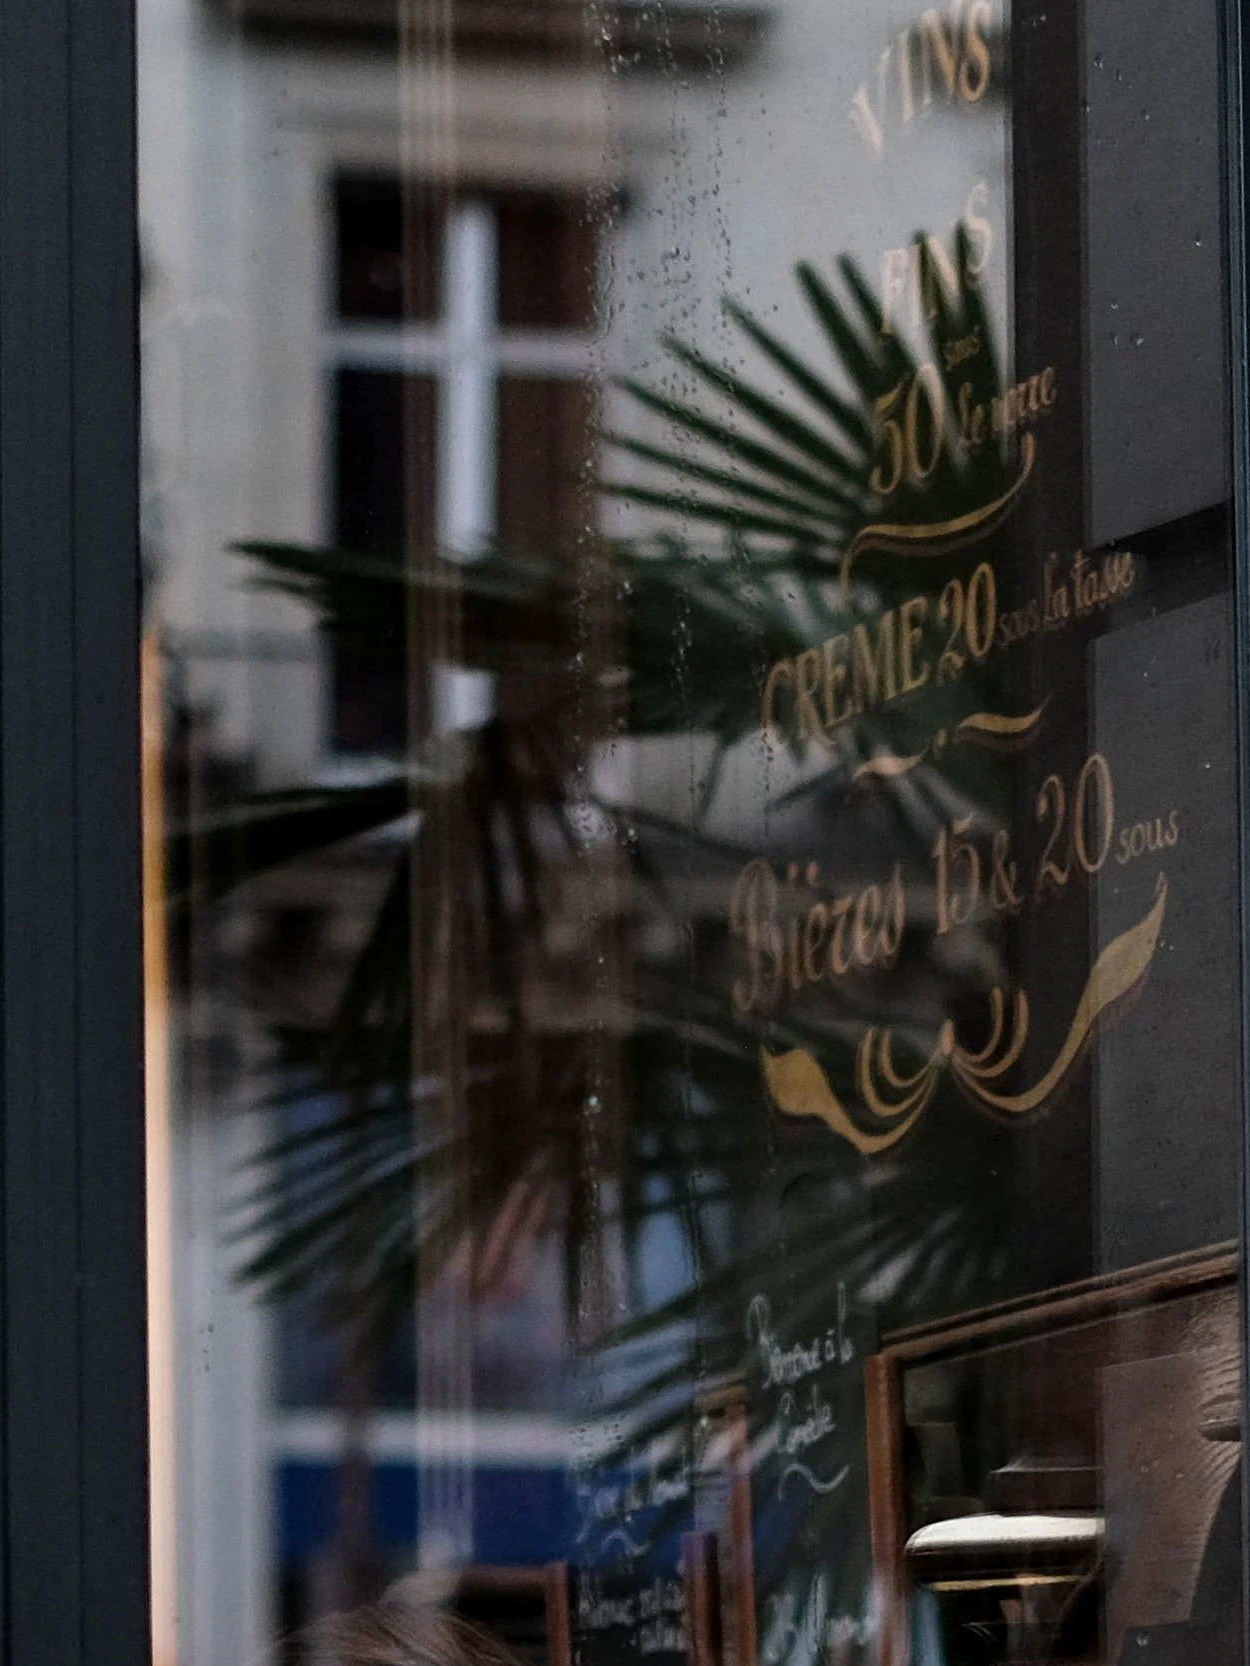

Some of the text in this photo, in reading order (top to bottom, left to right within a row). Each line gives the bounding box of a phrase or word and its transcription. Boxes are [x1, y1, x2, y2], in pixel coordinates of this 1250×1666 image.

[852, 0, 991, 152] VINS
[870, 362, 946, 495] 50
[936, 561, 996, 684] 20
[932, 811, 979, 934] 15
[991, 829, 1022, 909] &
[1036, 753, 1115, 885] 20
[1114, 810, 1180, 866] sous
